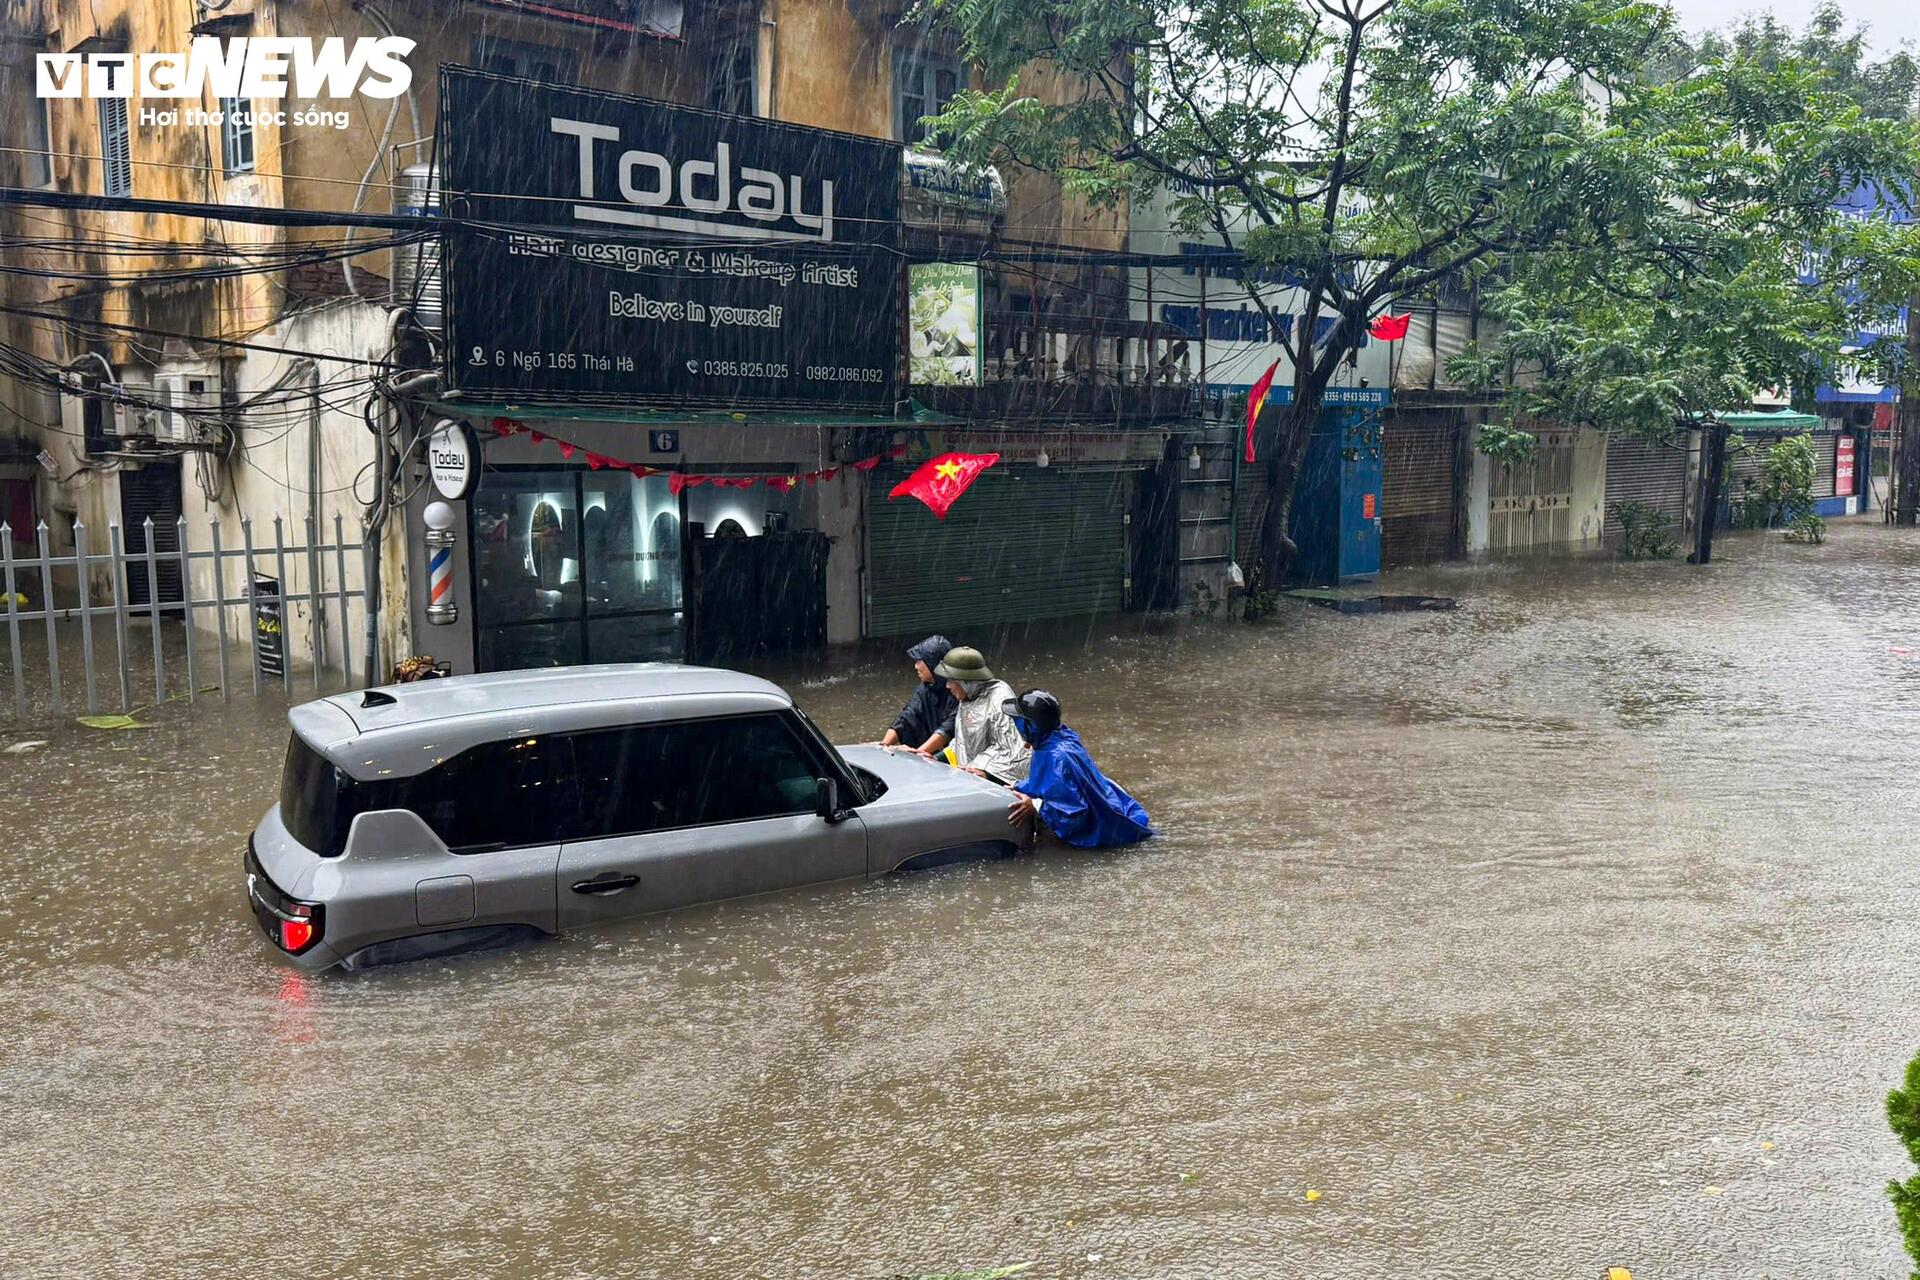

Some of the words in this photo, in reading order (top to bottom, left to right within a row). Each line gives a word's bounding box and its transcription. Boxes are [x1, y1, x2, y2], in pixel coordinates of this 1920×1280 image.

[550, 117, 834, 241] Today
[572, 242, 680, 273] designer
[802, 261, 859, 289] Artist
[609, 290, 685, 323] Believe
[686, 300, 706, 323] in
[709, 304, 783, 328] yourself
[495, 350, 506, 367] 6
[512, 350, 542, 372] Ngõ
[547, 352, 577, 370] 165
[582, 353, 611, 371] Thái
[616, 355, 635, 372] Hà
[703, 360, 789, 379] 0385.825.025
[805, 365, 884, 383] 0982.086.092
[656, 432, 673, 450] 6
[431, 449, 465, 470] Today
